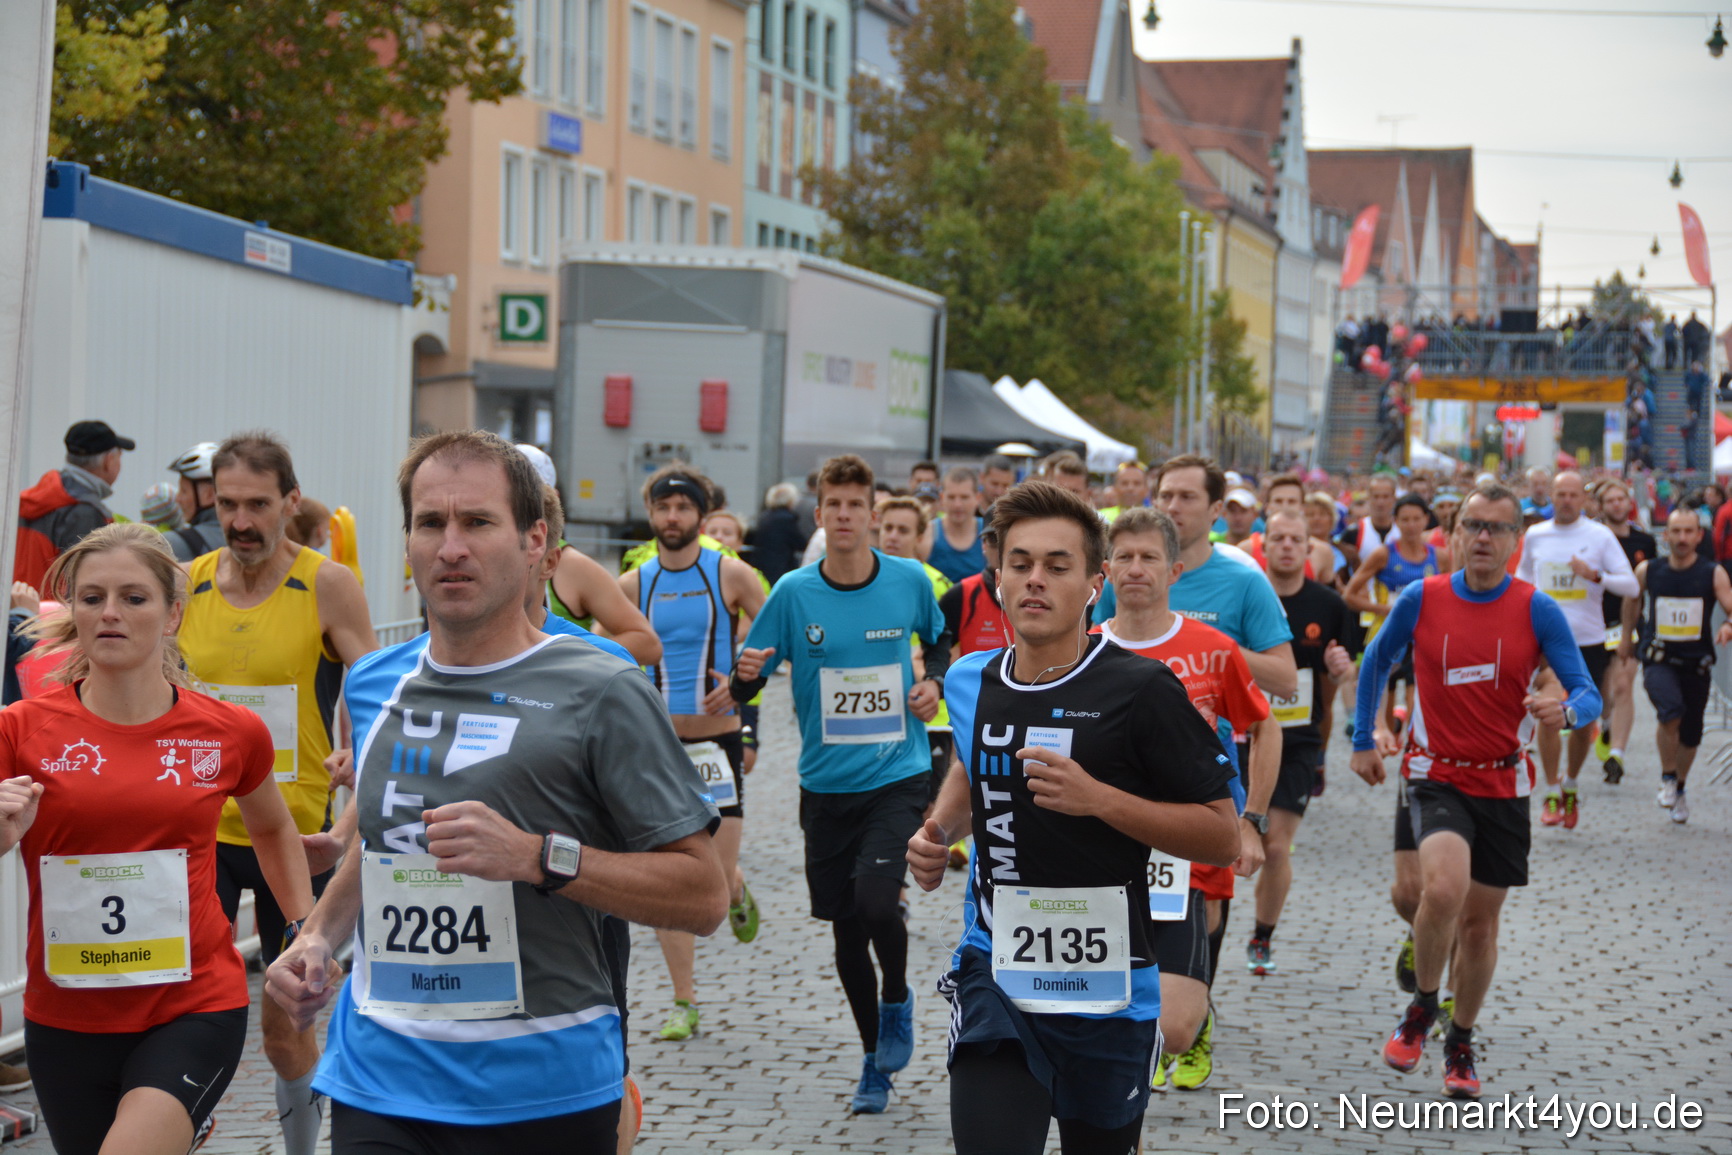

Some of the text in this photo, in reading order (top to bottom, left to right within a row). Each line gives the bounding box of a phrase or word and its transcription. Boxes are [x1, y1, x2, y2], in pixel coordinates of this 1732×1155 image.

[504, 299, 542, 336] D
[1672, 611, 1687, 625] 10
[865, 628, 903, 640] BOCK
[1160, 649, 1231, 679] aum
[834, 690, 891, 714] 2735
[462, 720, 498, 729] FERTIGUNG
[156, 738, 221, 748] TSV Wolfstein
[460, 733, 499, 741] MASCHINENBAU
[456, 743, 487, 752] FORMENBAU
[40, 758, 81, 774] Spitz
[699, 762, 723, 782] 09
[381, 708, 443, 855] ATEC
[979, 723, 1021, 881] MATEC
[94, 864, 144, 878] BOCK
[409, 870, 463, 883] BOCK
[1146, 862, 1174, 889] 35
[1042, 900, 1088, 911] BOCK
[101, 895, 127, 935] 3
[51, 931, 57, 939] A
[382, 904, 491, 955] 2284
[373, 945, 379, 954] B
[1013, 926, 1108, 964] 2135
[80, 948, 151, 966] Stephanie
[411, 972, 461, 991] Martin
[1033, 977, 1089, 992] Dominik
